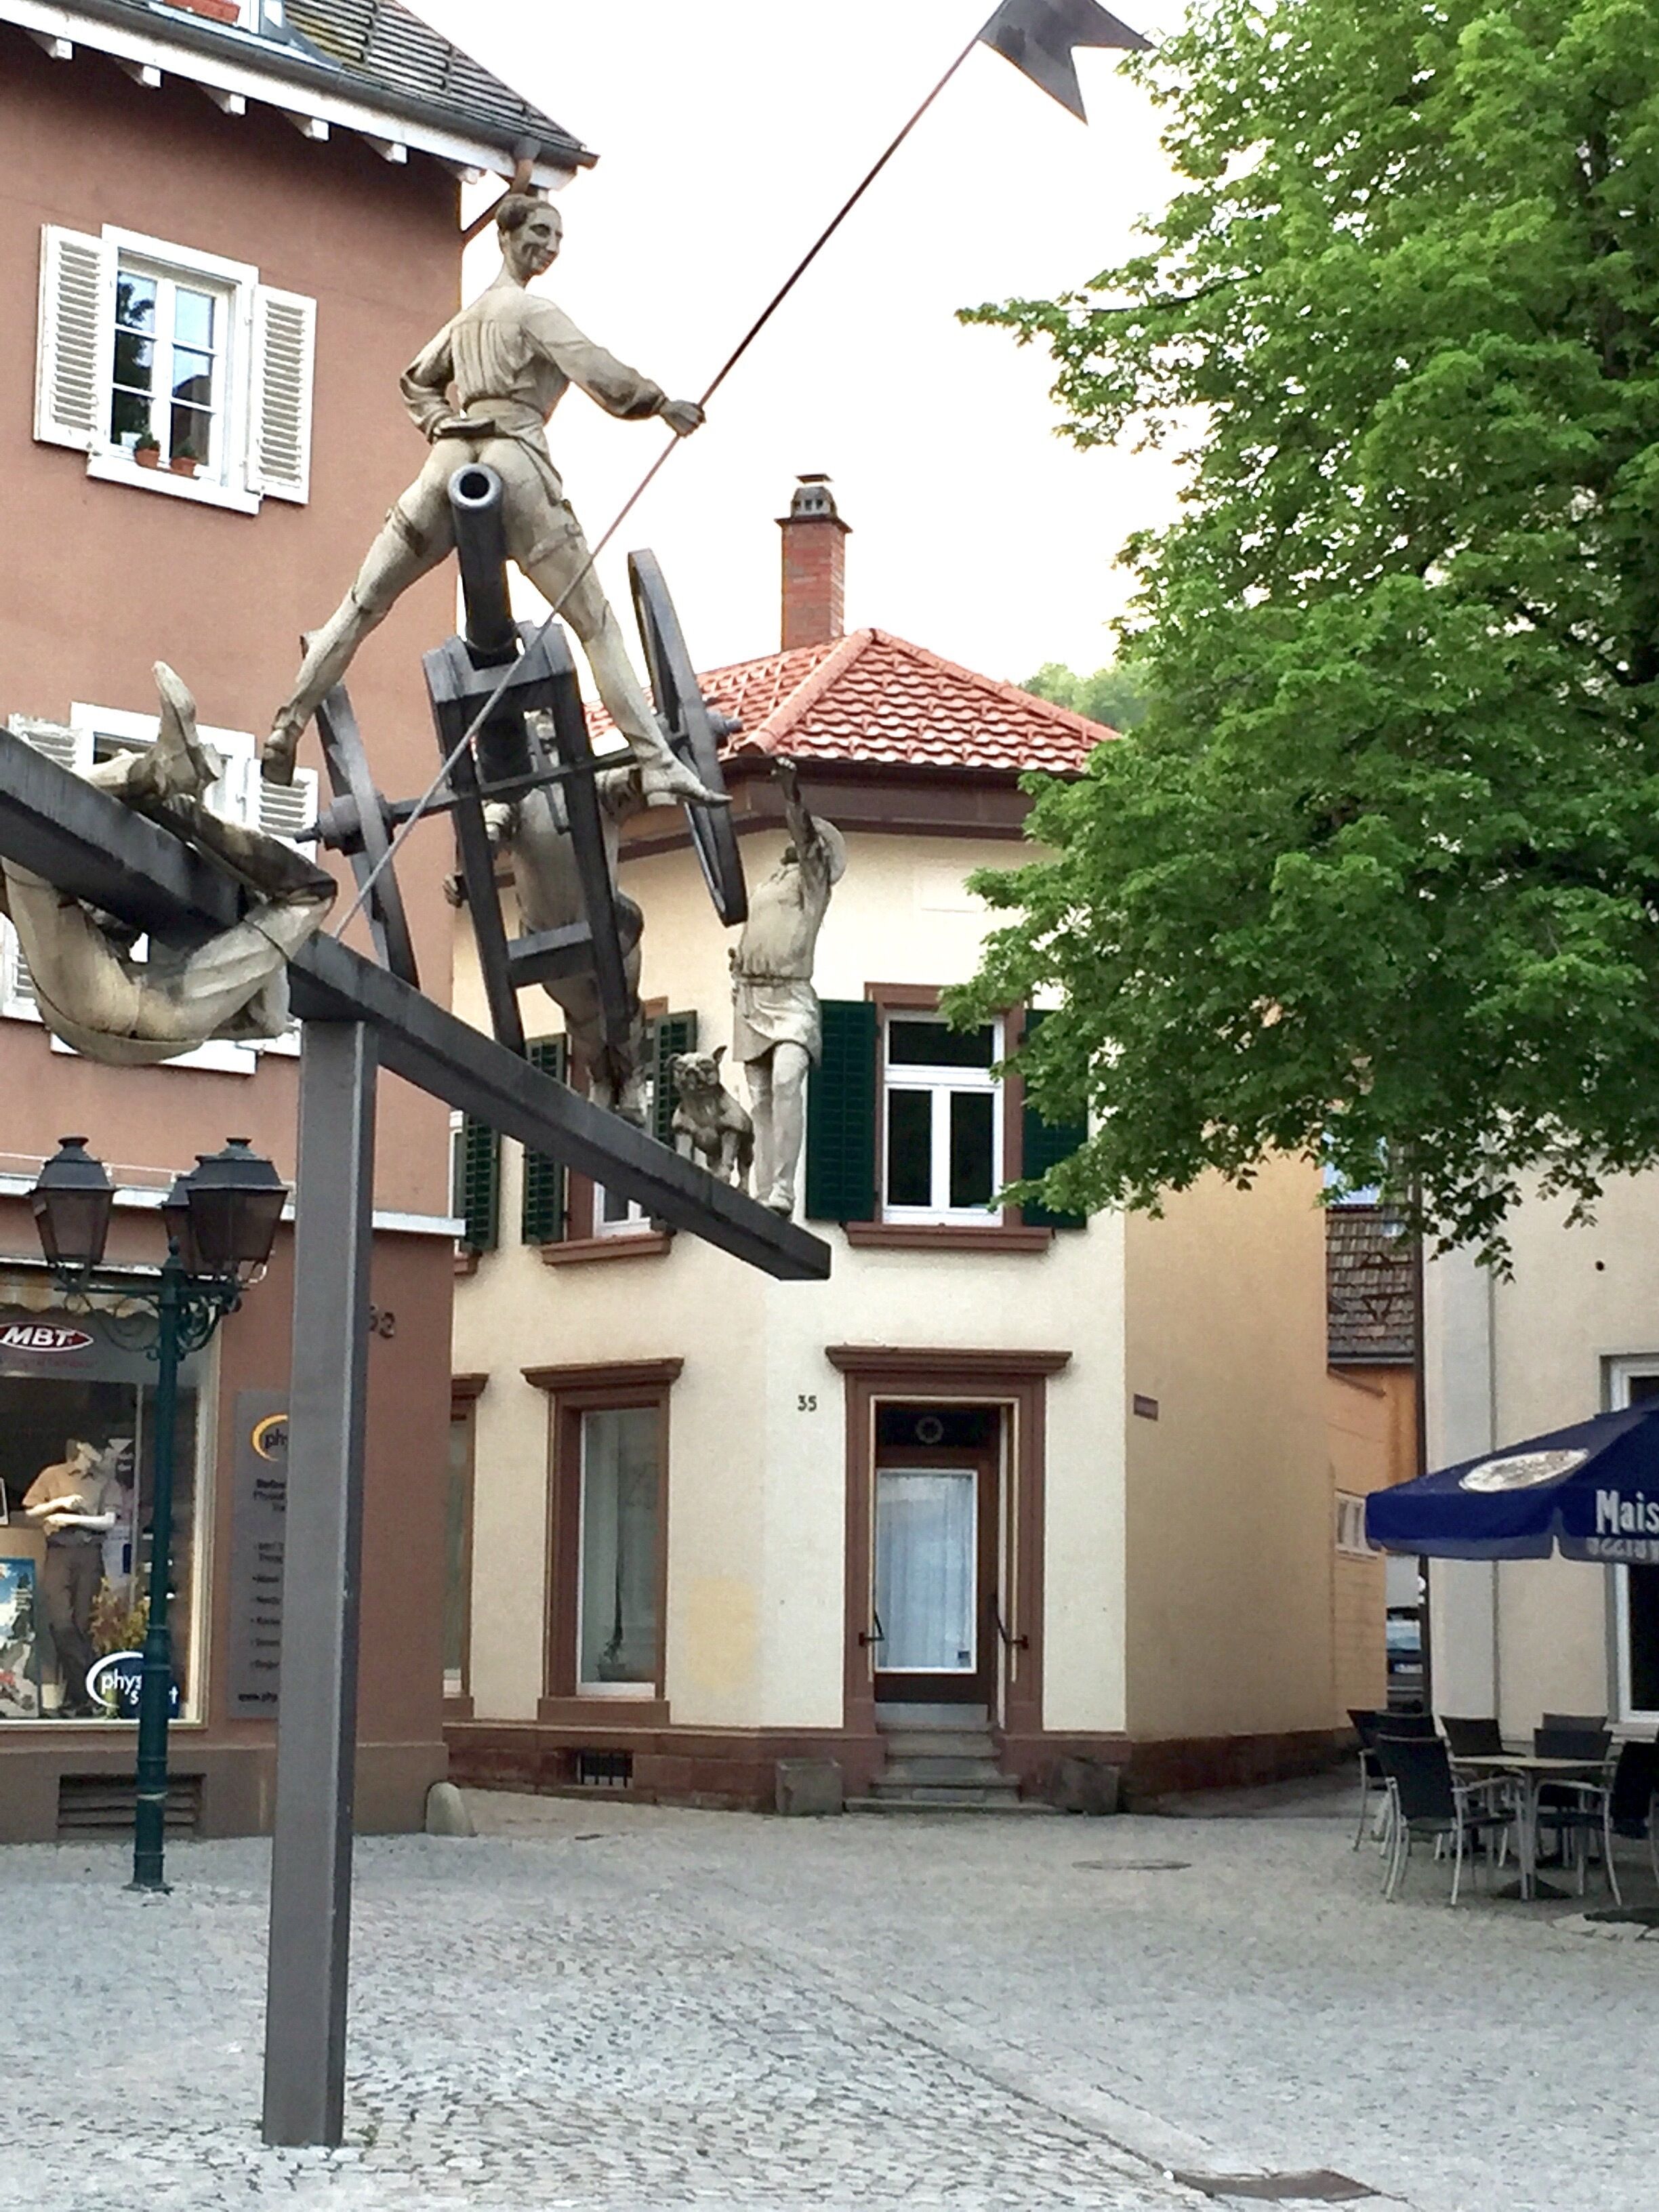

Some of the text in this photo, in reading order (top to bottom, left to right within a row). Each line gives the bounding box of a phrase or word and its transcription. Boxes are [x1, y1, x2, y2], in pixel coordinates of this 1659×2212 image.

[1, 1326, 75, 1347] MBT
[798, 1394, 817, 1412] 35
[1595, 1488, 1659, 1535] Mais
